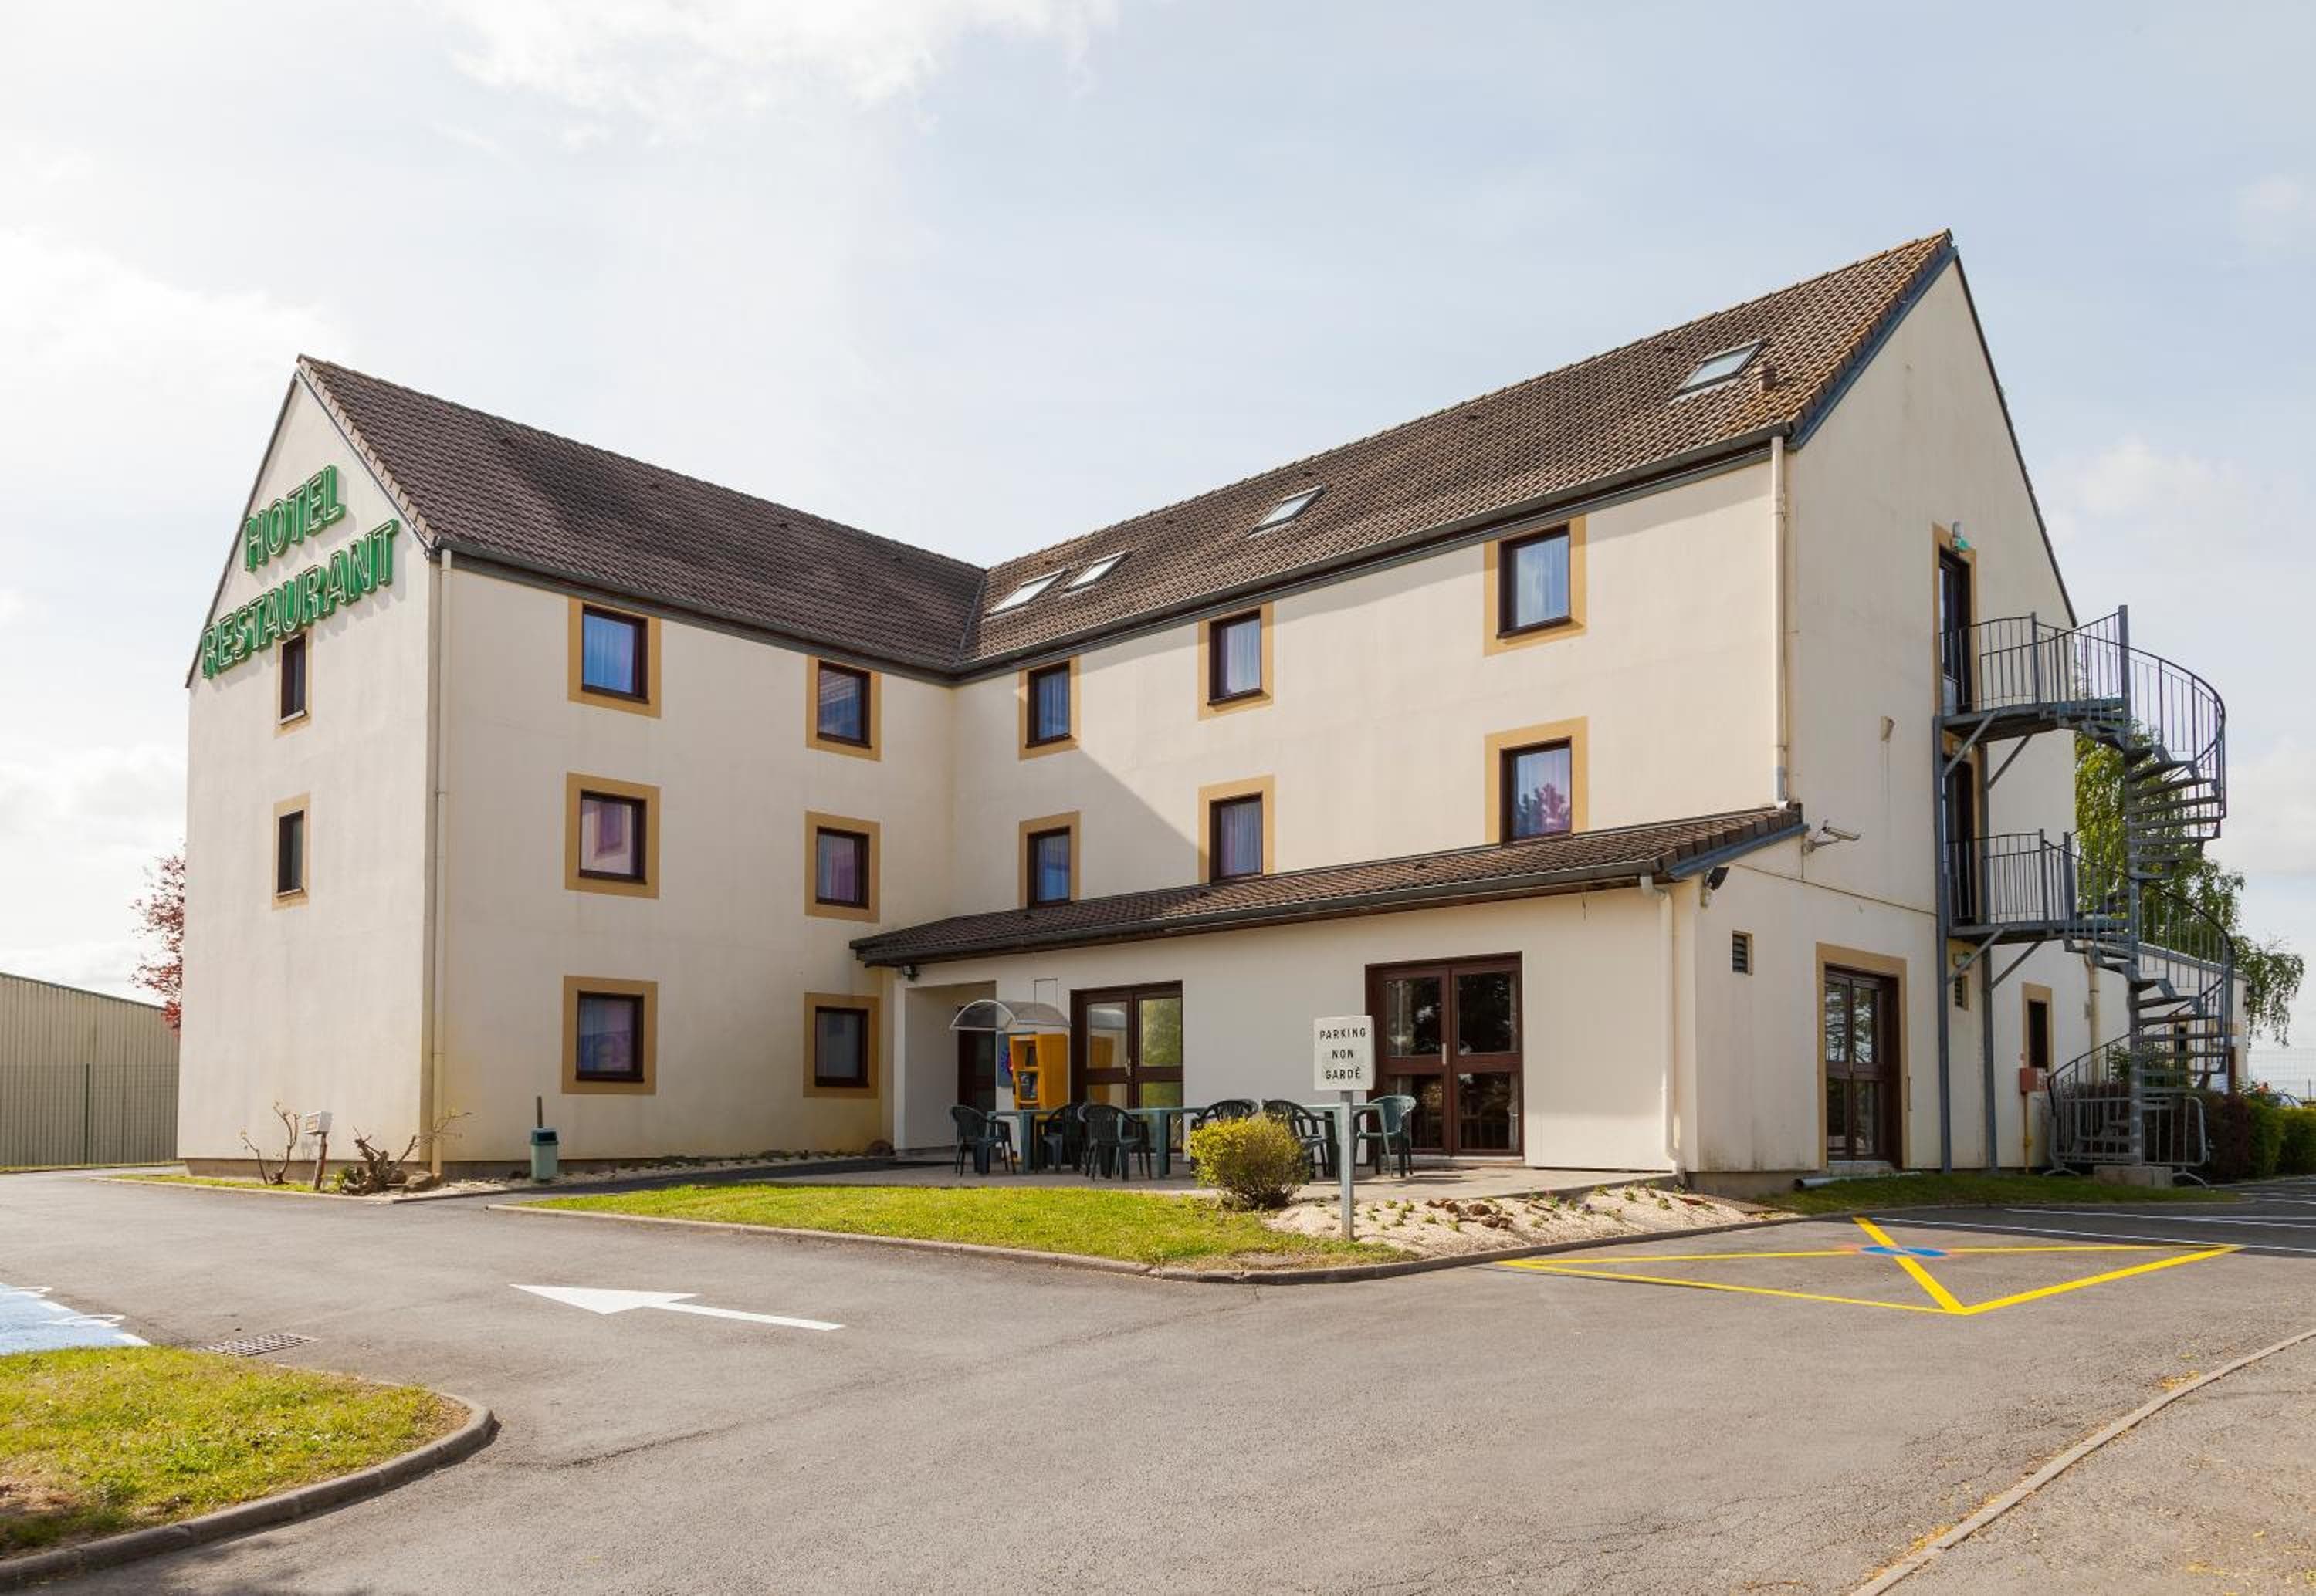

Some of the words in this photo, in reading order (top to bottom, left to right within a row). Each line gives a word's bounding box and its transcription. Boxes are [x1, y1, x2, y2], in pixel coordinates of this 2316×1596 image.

[245, 464, 346, 571] HOTEL
[201, 518, 401, 679] RESTAURANT
[1320, 1027, 1366, 1040] PARKING
[1332, 1050, 1353, 1059] NON
[1326, 1067, 1361, 1080] GARDÉ
